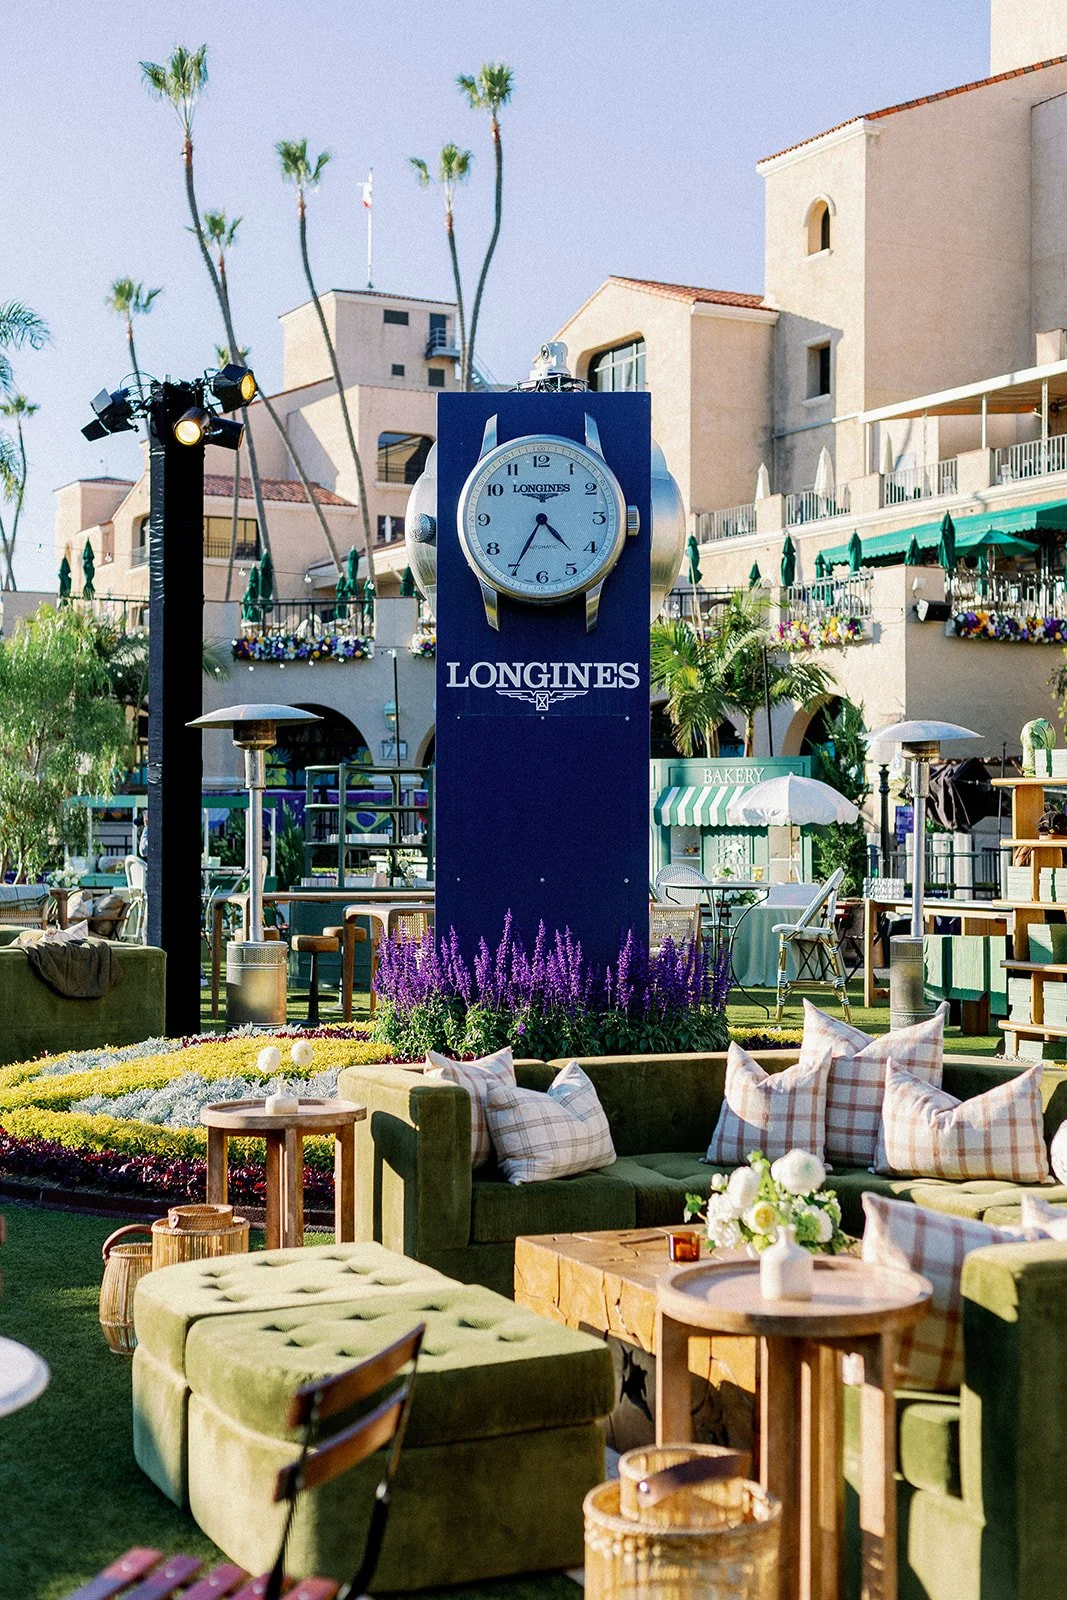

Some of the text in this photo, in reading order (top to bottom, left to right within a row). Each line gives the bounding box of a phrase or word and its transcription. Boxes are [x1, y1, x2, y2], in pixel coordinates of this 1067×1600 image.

[532, 454, 550, 468] 12
[507, 463, 518, 476] 11
[568, 462, 574, 476] 1
[487, 483, 504, 497] 10
[512, 483, 571, 493] LONGINES
[584, 482, 598, 496] 2
[477, 512, 491, 527] 9
[592, 511, 607, 525] 3
[486, 541, 500, 556] 8
[582, 540, 598, 554] 4
[507, 563, 521, 577] 7
[564, 562, 578, 576] 5
[535, 570, 550, 585] 6
[446, 661, 641, 689] LONGINES
[703, 767, 766, 785] BAKERY
